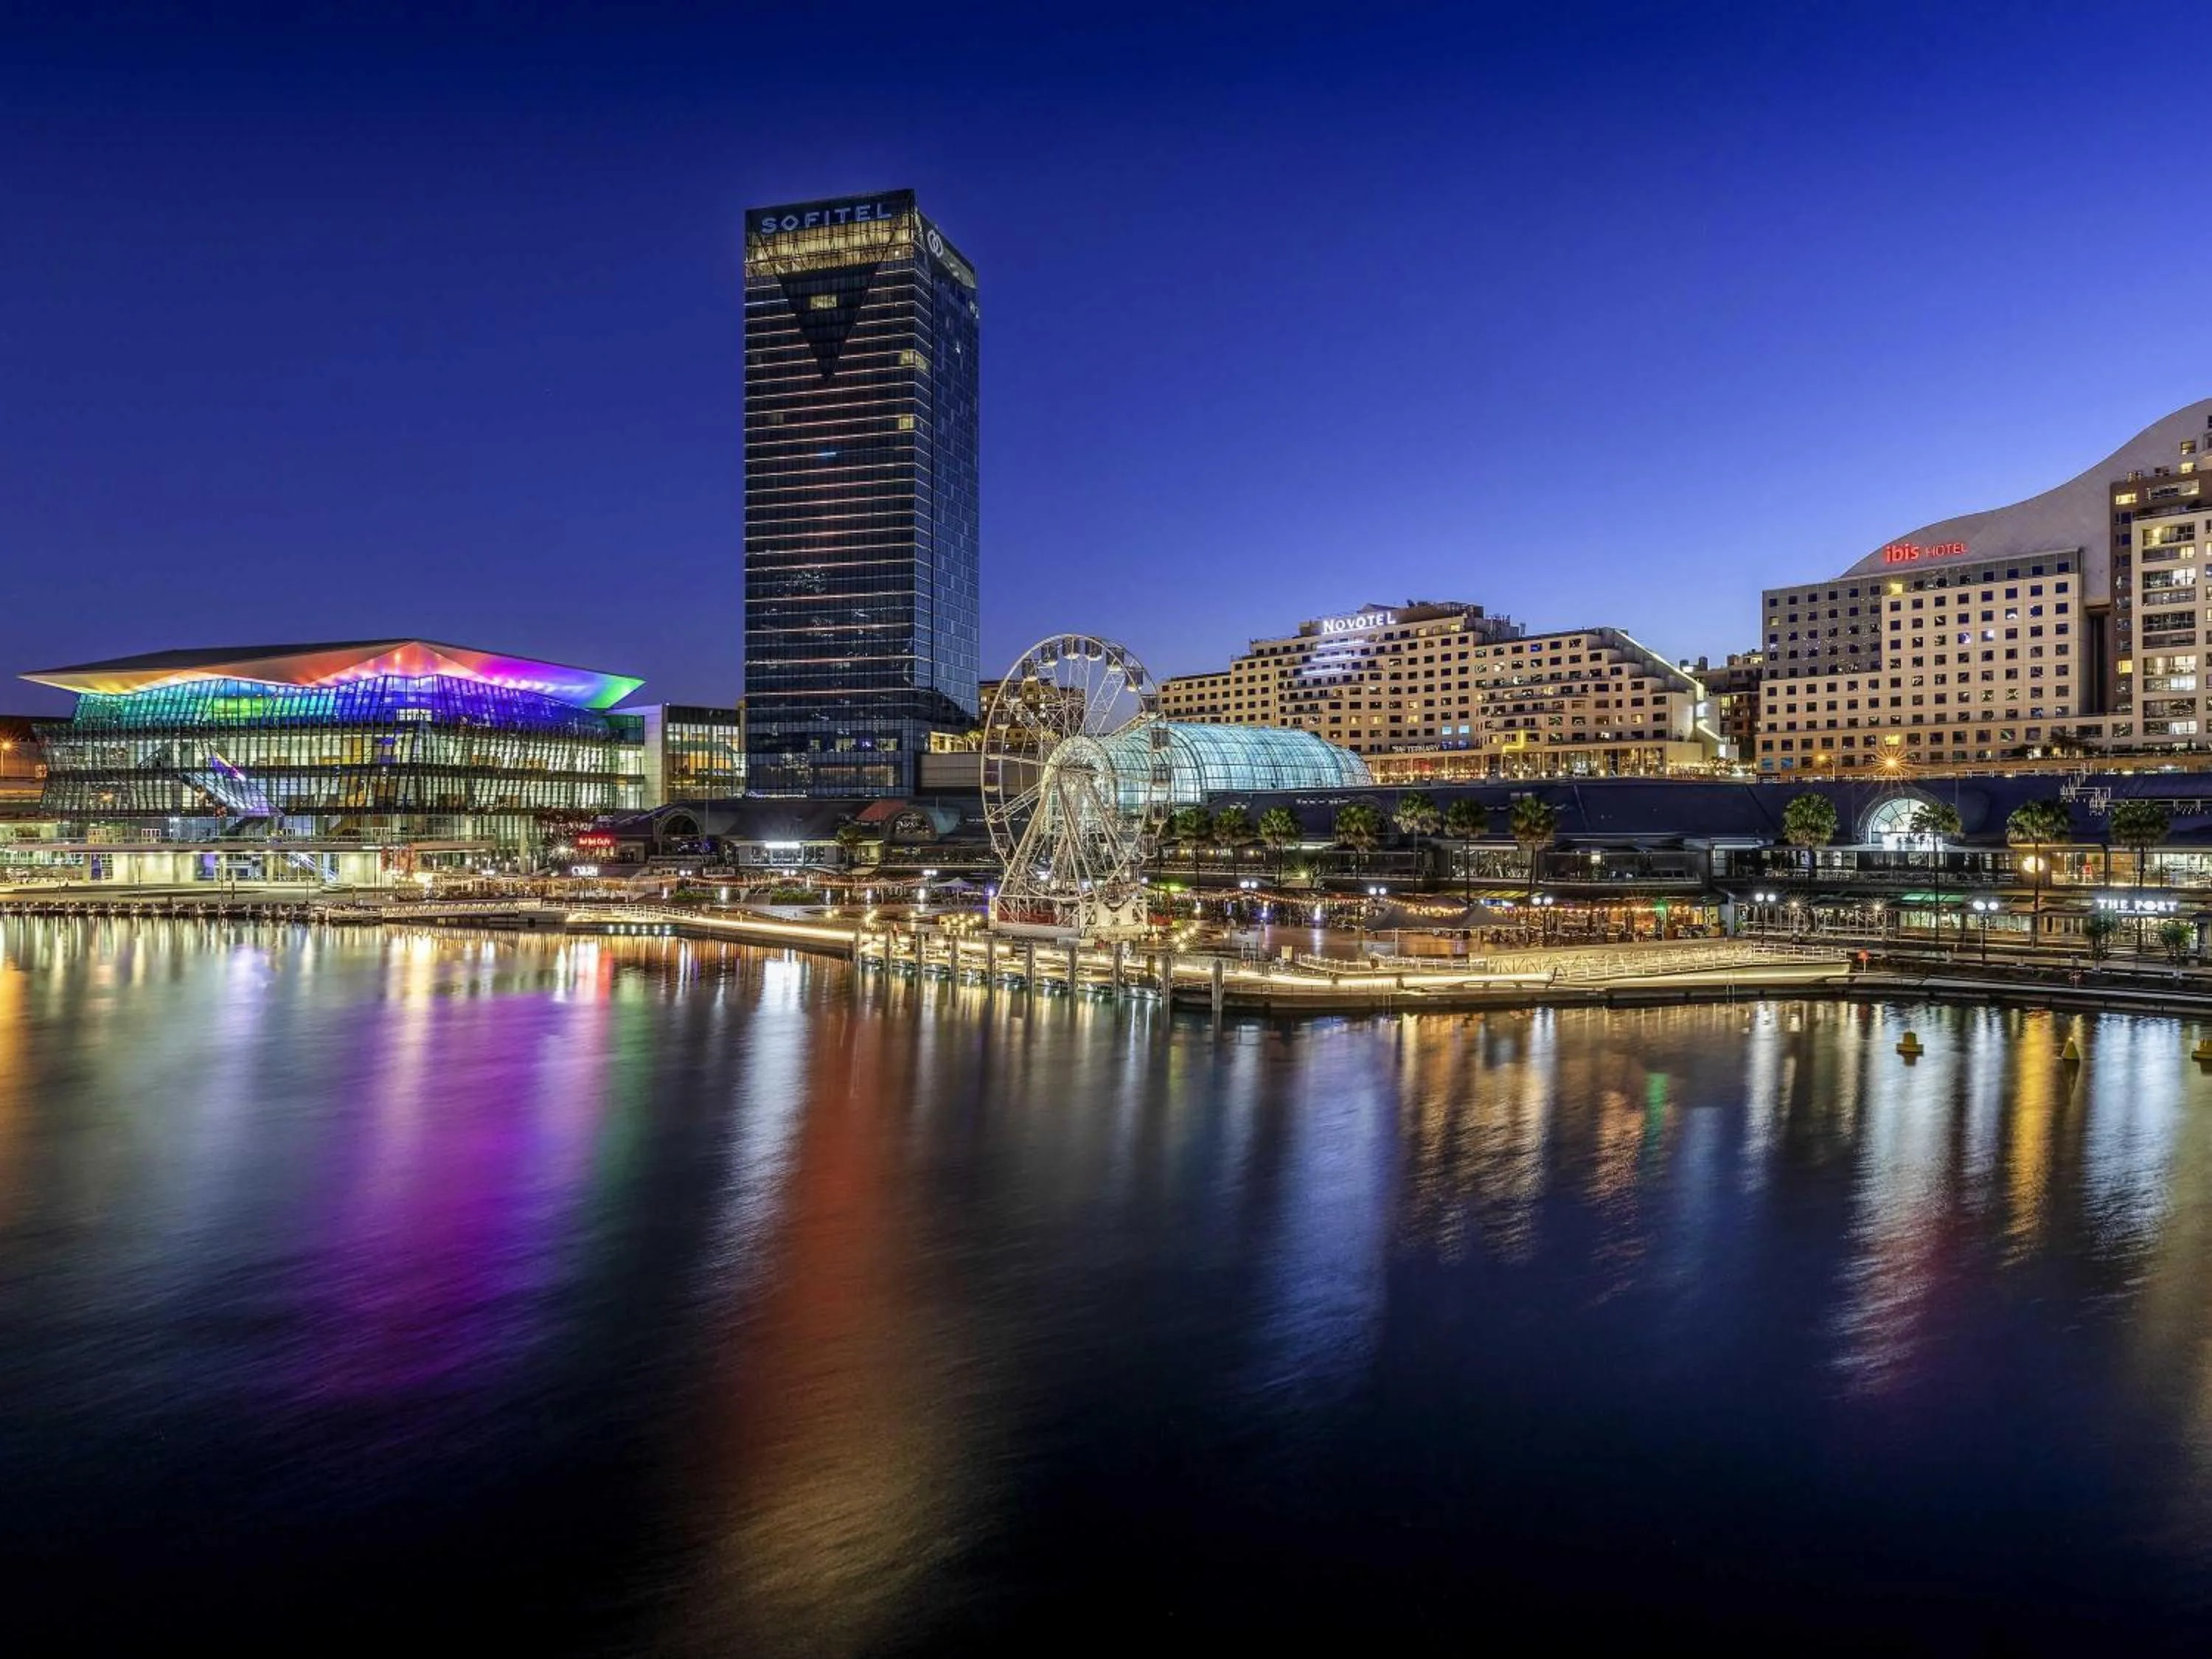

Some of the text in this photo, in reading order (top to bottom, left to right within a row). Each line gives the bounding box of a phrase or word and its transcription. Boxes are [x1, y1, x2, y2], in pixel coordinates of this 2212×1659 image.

[761, 203, 891, 234] SOFITEL
[1886, 542, 1969, 563] ibis HOTEL
[1323, 611, 1397, 633] NOVOTEL
[2096, 899, 2177, 911] THE PORT
